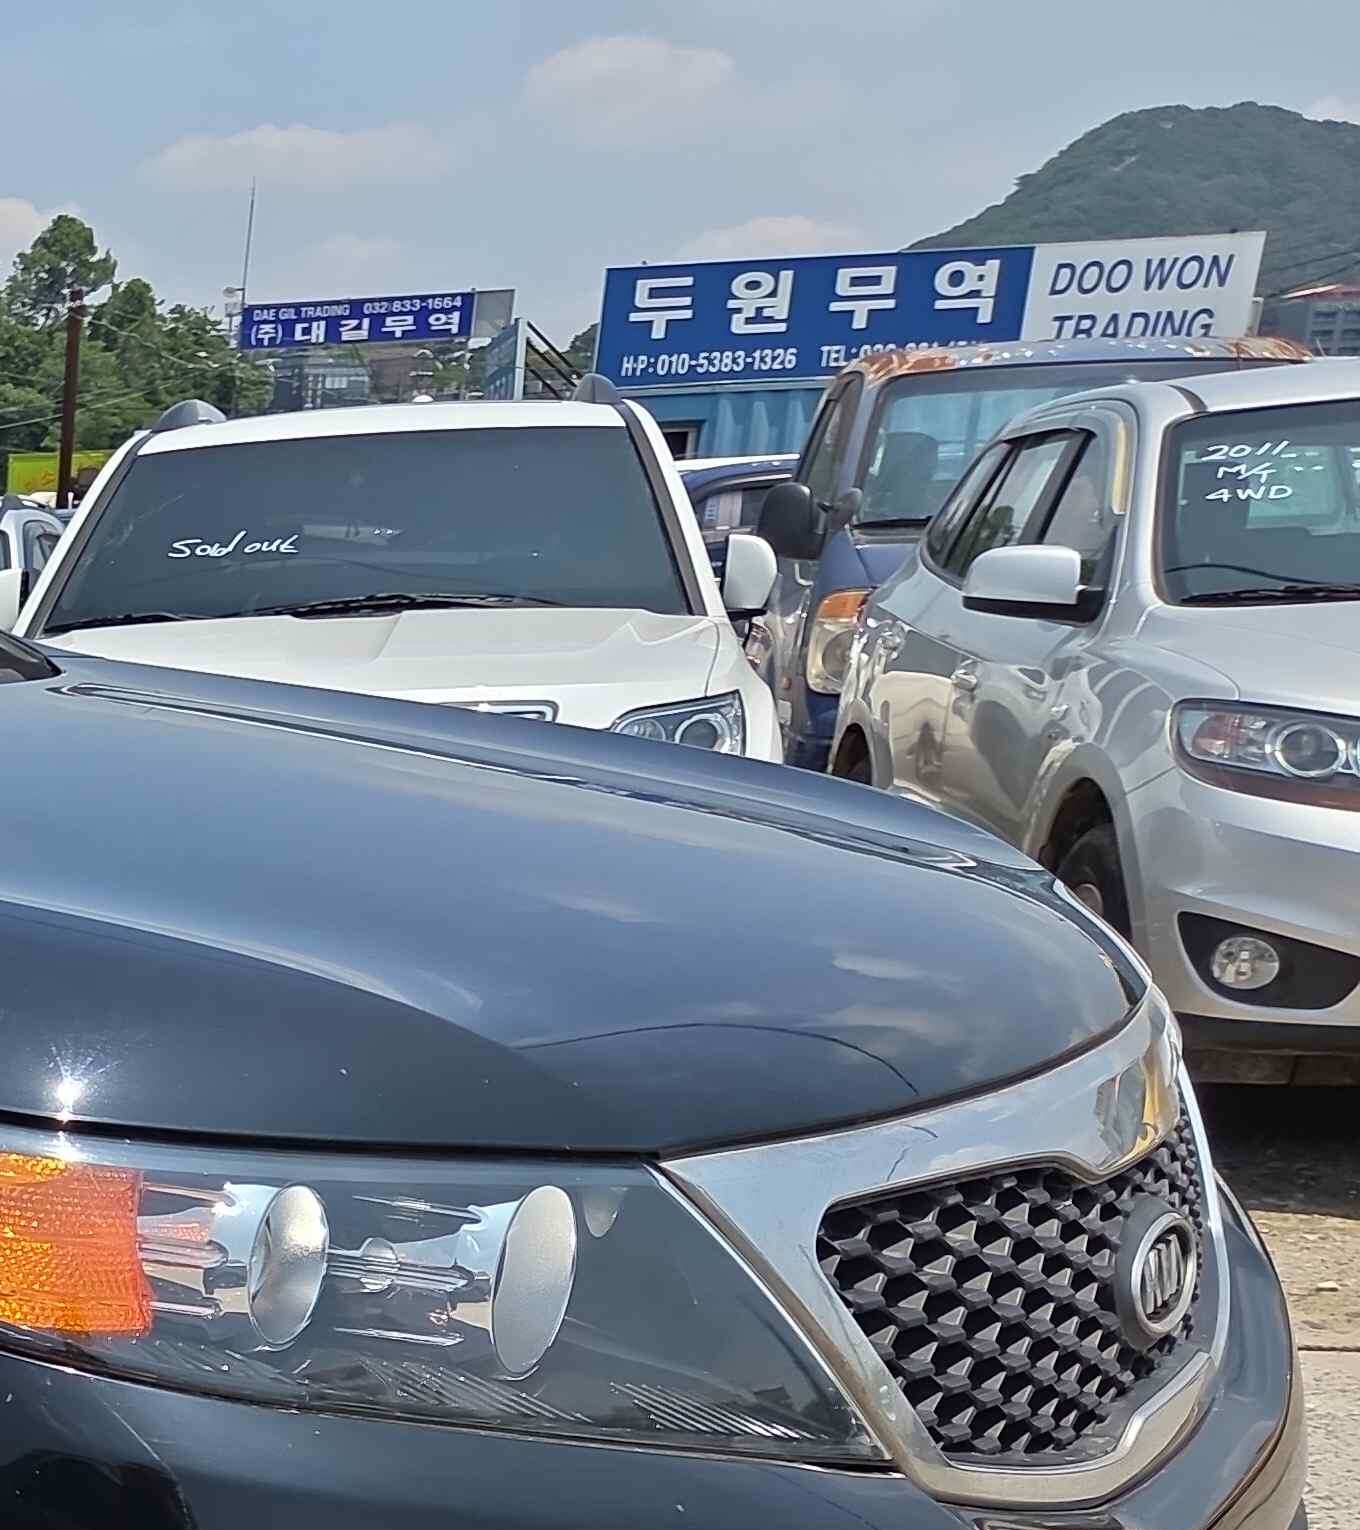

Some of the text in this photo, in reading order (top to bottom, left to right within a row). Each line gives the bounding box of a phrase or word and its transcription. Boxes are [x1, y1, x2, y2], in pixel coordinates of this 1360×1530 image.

[1049, 254, 1235, 296] DOO WON
[253, 309, 276, 321] DAE
[279, 308, 298, 320] GIL
[300, 304, 350, 319] TRADING
[1052, 307, 1216, 340] TRADING
[1201, 440, 1290, 461] 2011
[1205, 485, 1293, 502] 4WD
